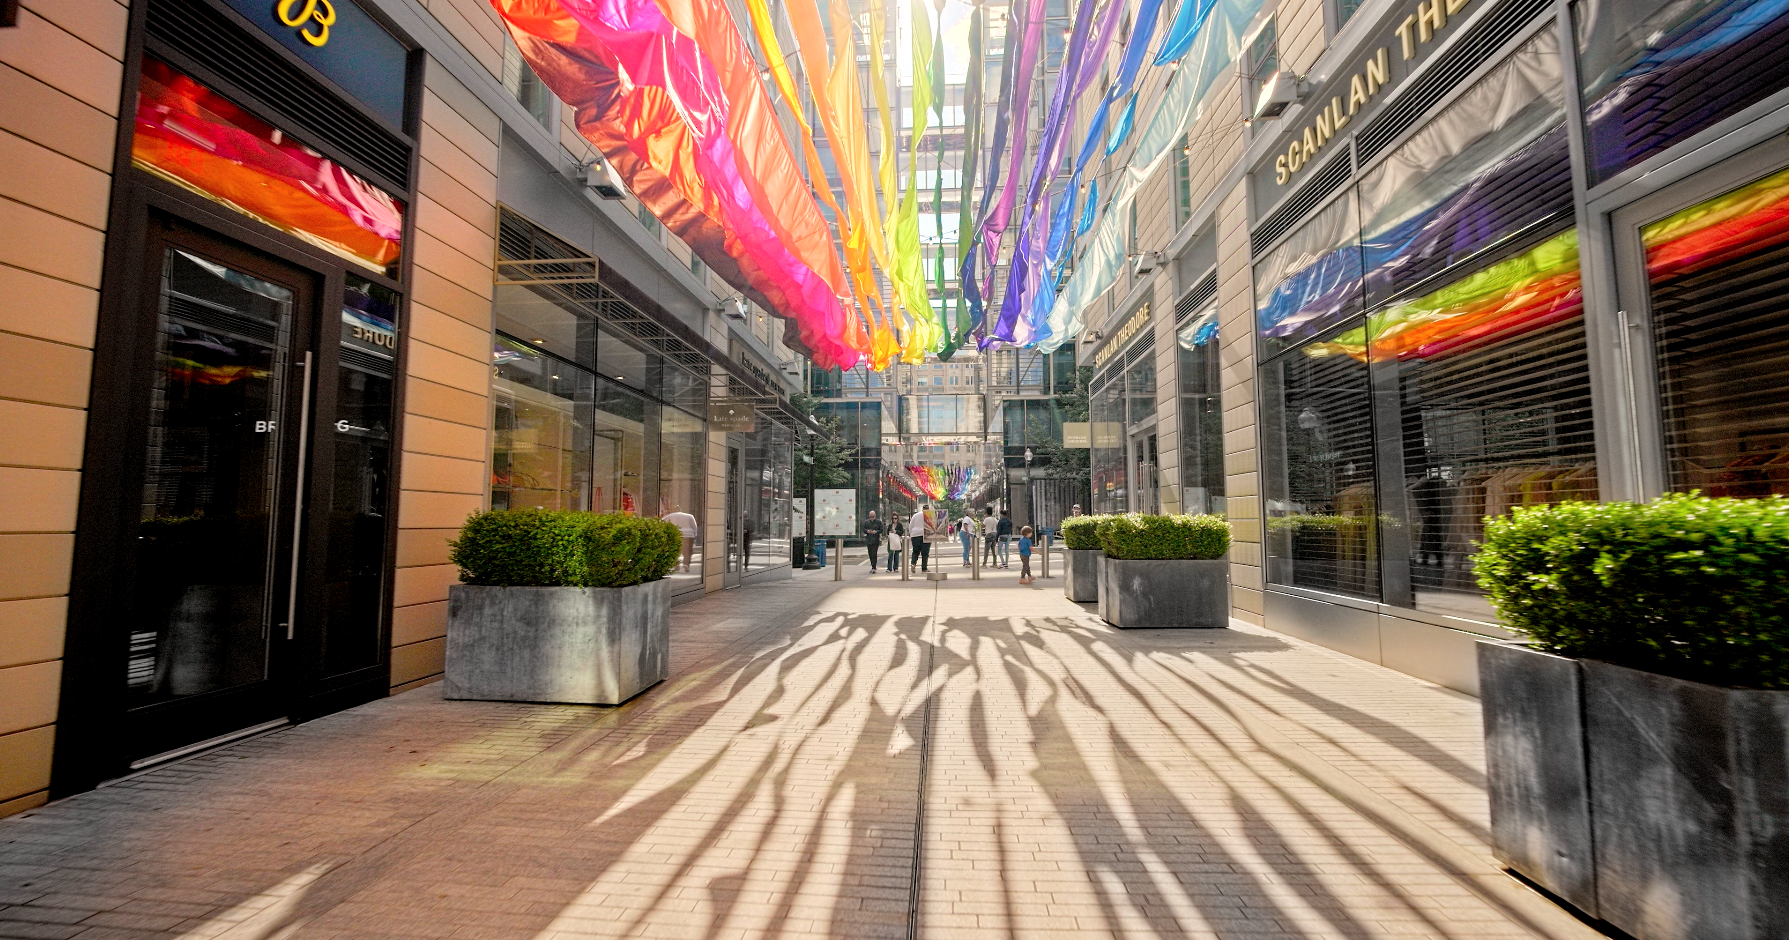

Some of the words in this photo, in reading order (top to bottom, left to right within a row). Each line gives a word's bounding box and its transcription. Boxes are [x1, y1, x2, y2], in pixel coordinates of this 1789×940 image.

[1275, 46, 1391, 186] SCANLAN
[1095, 335, 1119, 369] SCANLAN
[1117, 301, 1152, 347] THEODORE
